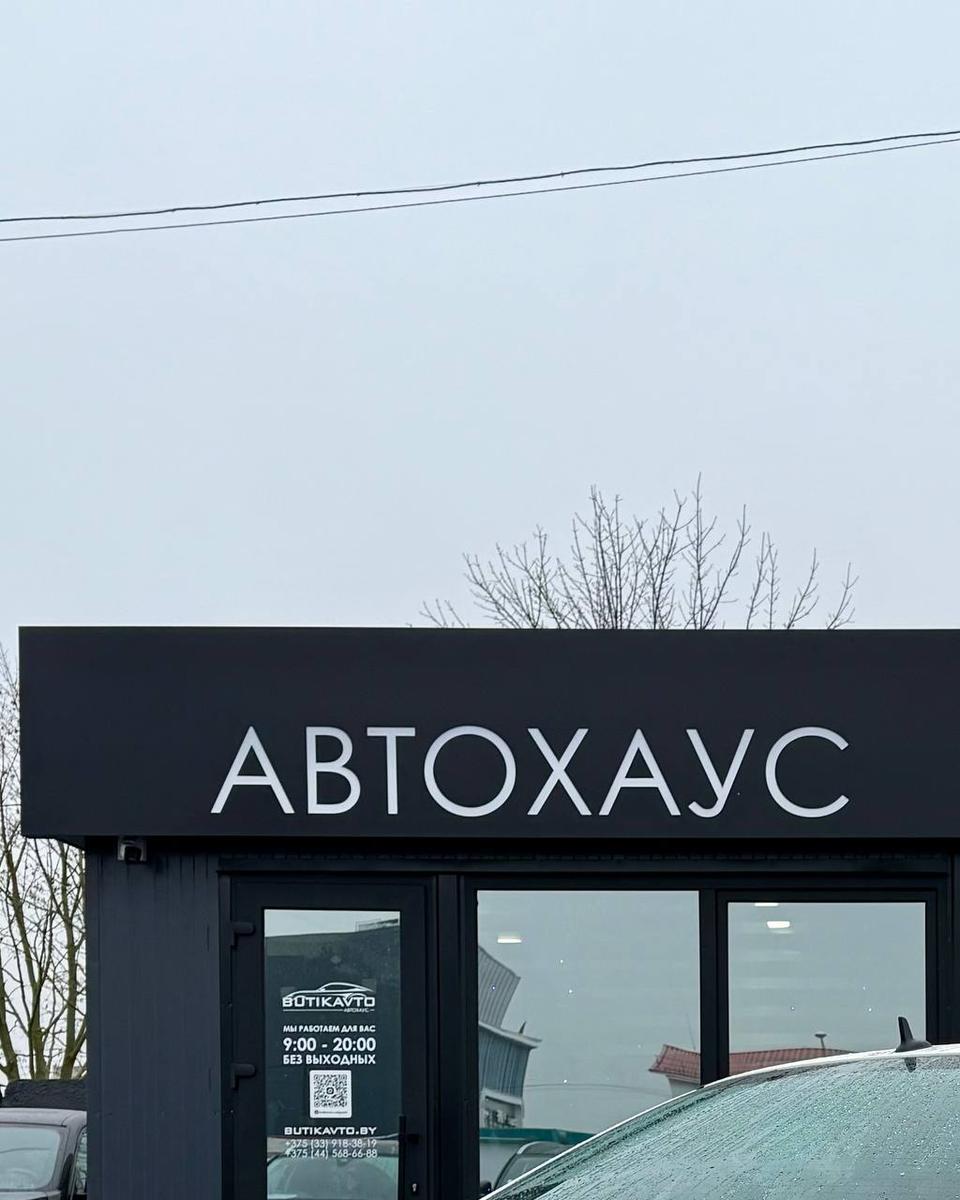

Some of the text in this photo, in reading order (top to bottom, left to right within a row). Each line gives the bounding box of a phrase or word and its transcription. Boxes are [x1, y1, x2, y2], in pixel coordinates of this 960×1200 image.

[210, 725, 850, 818] АВТОХАУС
[282, 996, 376, 1008] BUTIKAVTO
[283, 1025, 376, 1033] МЫ РАБОТАЕМ ДЛЯ ВАС
[283, 1037, 317, 1052] 9:00
[333, 1037, 377, 1052] 20:00
[283, 1054, 377, 1066] БЕЗ ВЫХОДНЫХ
[284, 1126, 377, 1135] BUTIKAVTO.BY
[285, 1139, 377, 1150] +375 (33) 918-38-19
[310, 1148, 328, 1160] (44)
[332, 1149, 378, 1159] 568-66-88
